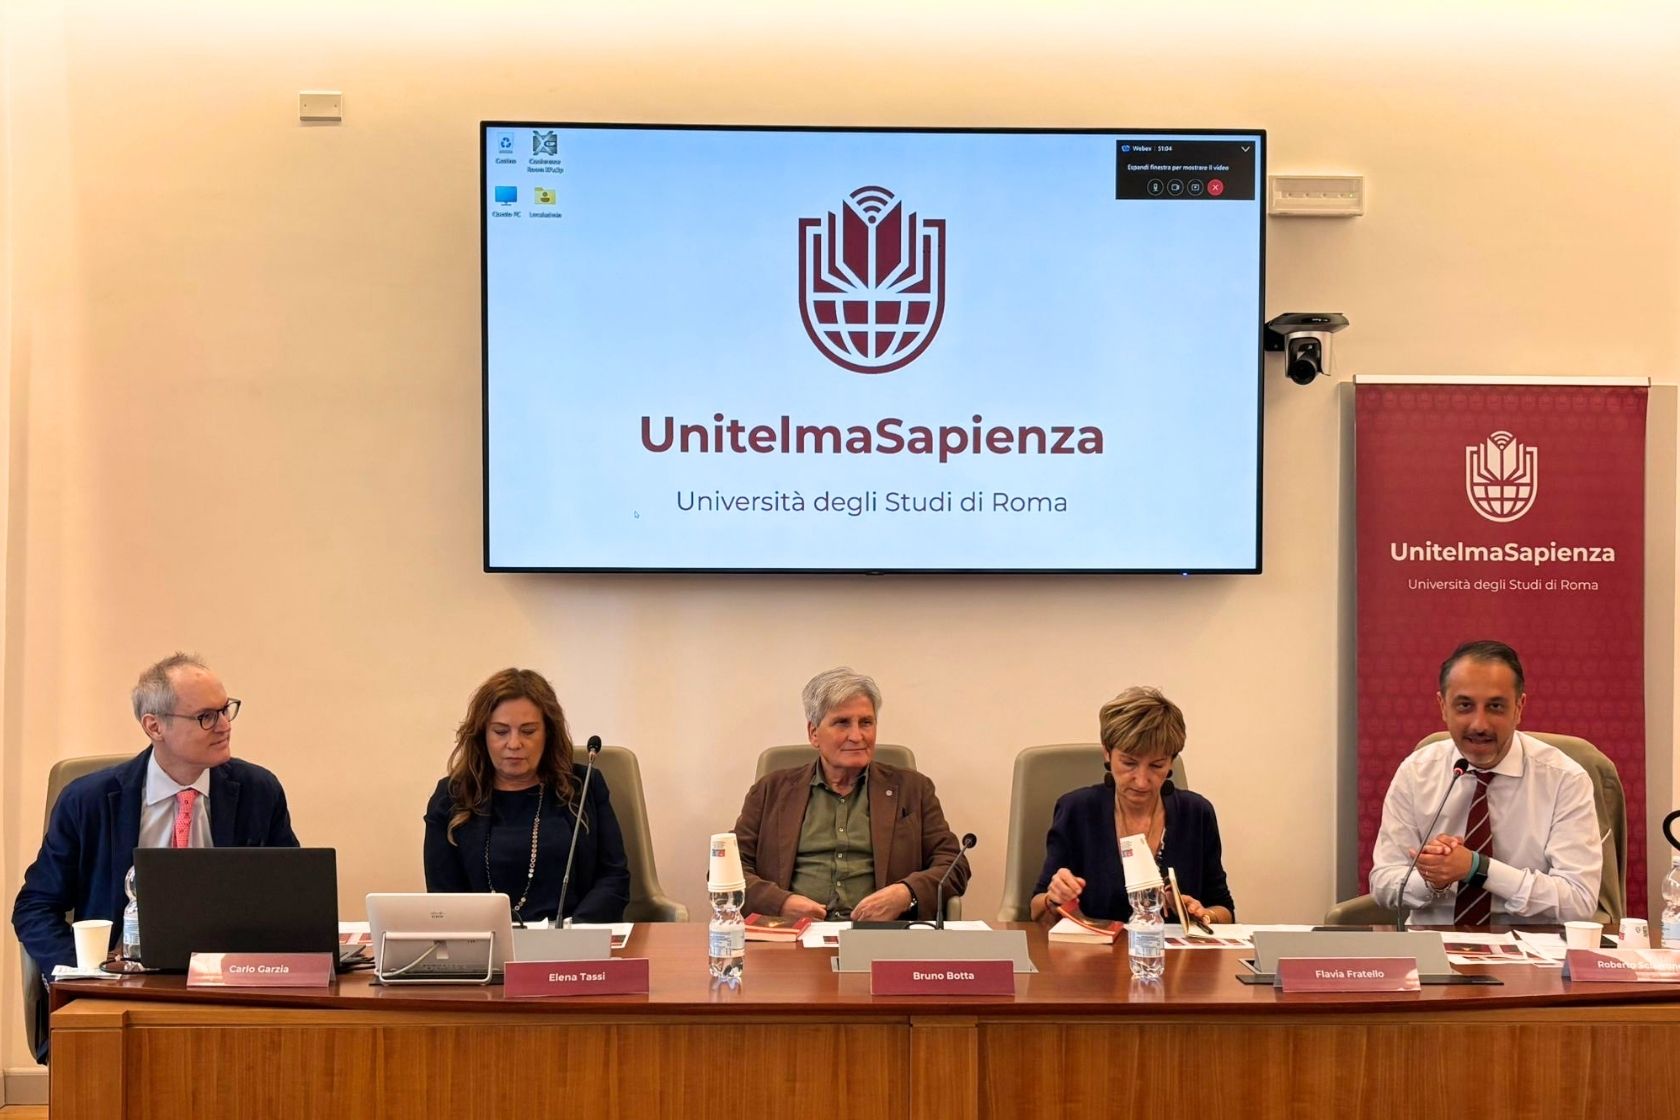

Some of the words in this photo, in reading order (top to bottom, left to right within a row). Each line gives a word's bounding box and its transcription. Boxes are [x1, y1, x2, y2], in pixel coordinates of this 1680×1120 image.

[641, 413, 1104, 463] UnitelmaSapienza
[677, 490, 805, 512] Università
[813, 490, 877, 516] degli
[885, 491, 952, 512] Studi
[962, 490, 984, 512] di
[993, 492, 1068, 513] Roma
[1390, 541, 1616, 565] UnitelmaSapienza
[1408, 578, 1471, 590] Università
[1474, 578, 1506, 592] degli
[1509, 579, 1542, 591] Studi
[1545, 579, 1557, 590] di
[1561, 580, 1599, 591] Roma
[229, 964, 255, 974] Carlo
[257, 964, 289, 974] Garzia
[913, 971, 944, 980] Bruno
[946, 971, 975, 980] Botta
[1315, 968, 1344, 979] Flavia
[1346, 969, 1385, 980] Fratello
[548, 973, 577, 982] Elena
[580, 972, 605, 981] Tassi
